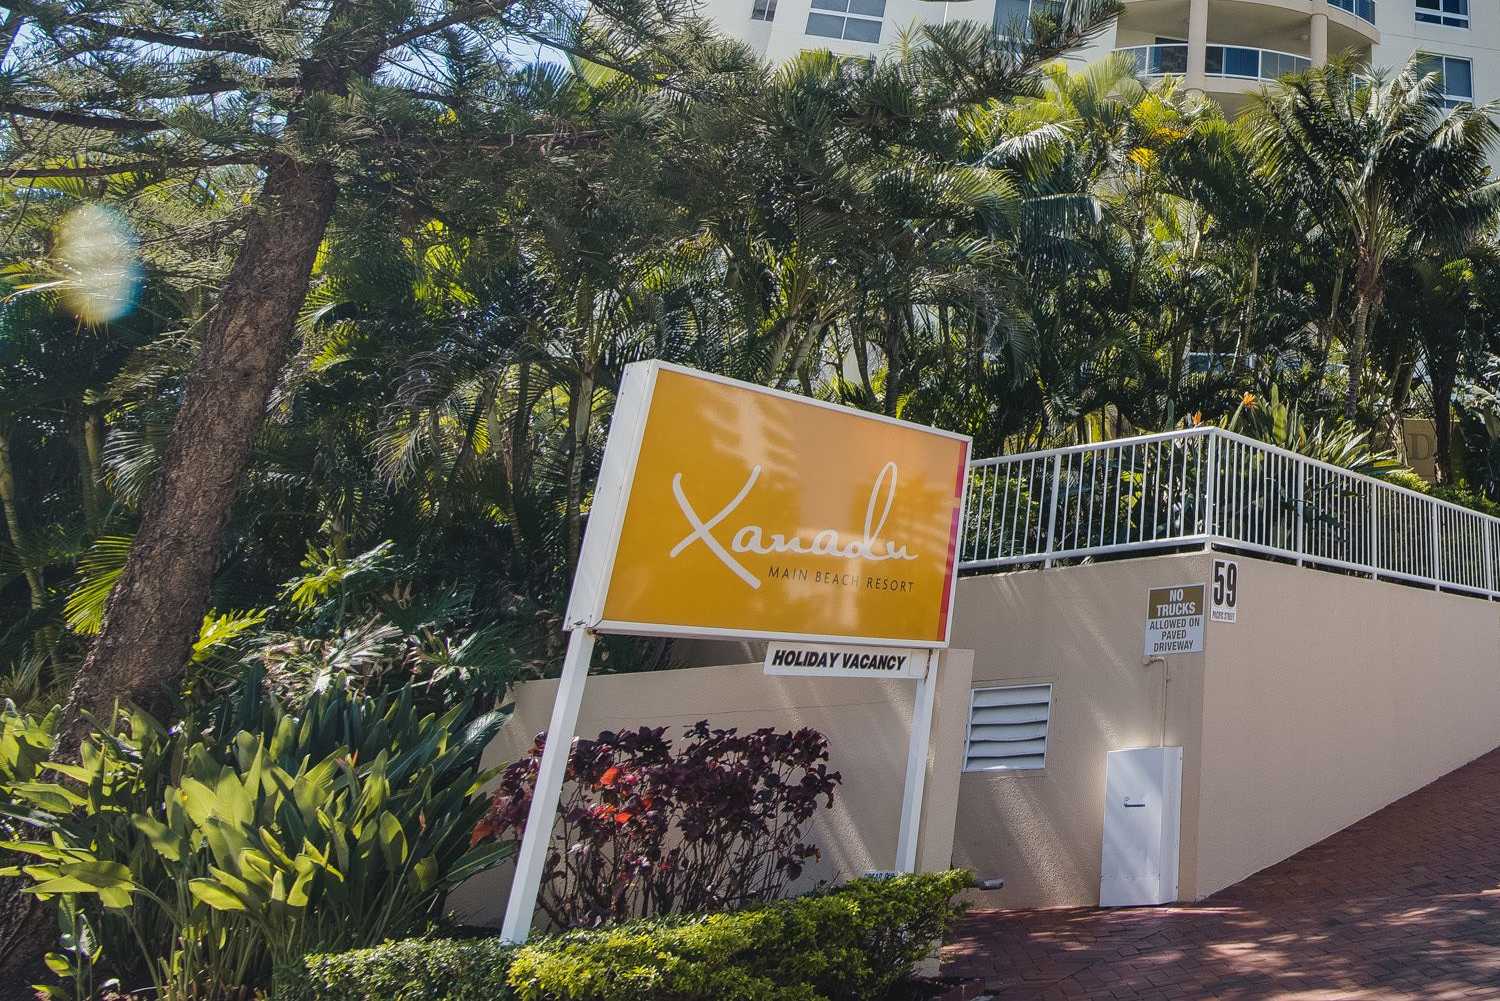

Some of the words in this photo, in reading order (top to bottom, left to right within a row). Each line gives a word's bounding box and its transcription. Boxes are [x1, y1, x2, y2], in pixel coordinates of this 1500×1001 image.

[669, 461, 918, 589] Xanadu
[768, 566, 808, 581] MAIN
[815, 571, 859, 587] BEACH
[866, 577, 914, 593] RESORT
[1214, 561, 1237, 608] 59
[1170, 589, 1184, 602] NO
[1156, 602, 1196, 617] TRUCKS
[1150, 619, 1187, 630] ALLOWED
[1189, 618, 1200, 627] ON
[1162, 630, 1187, 640] PAVED
[1153, 640, 1194, 652] DRIVEWAY
[771, 649, 840, 669] HOLIDAY
[842, 653, 907, 671] VACANCY
